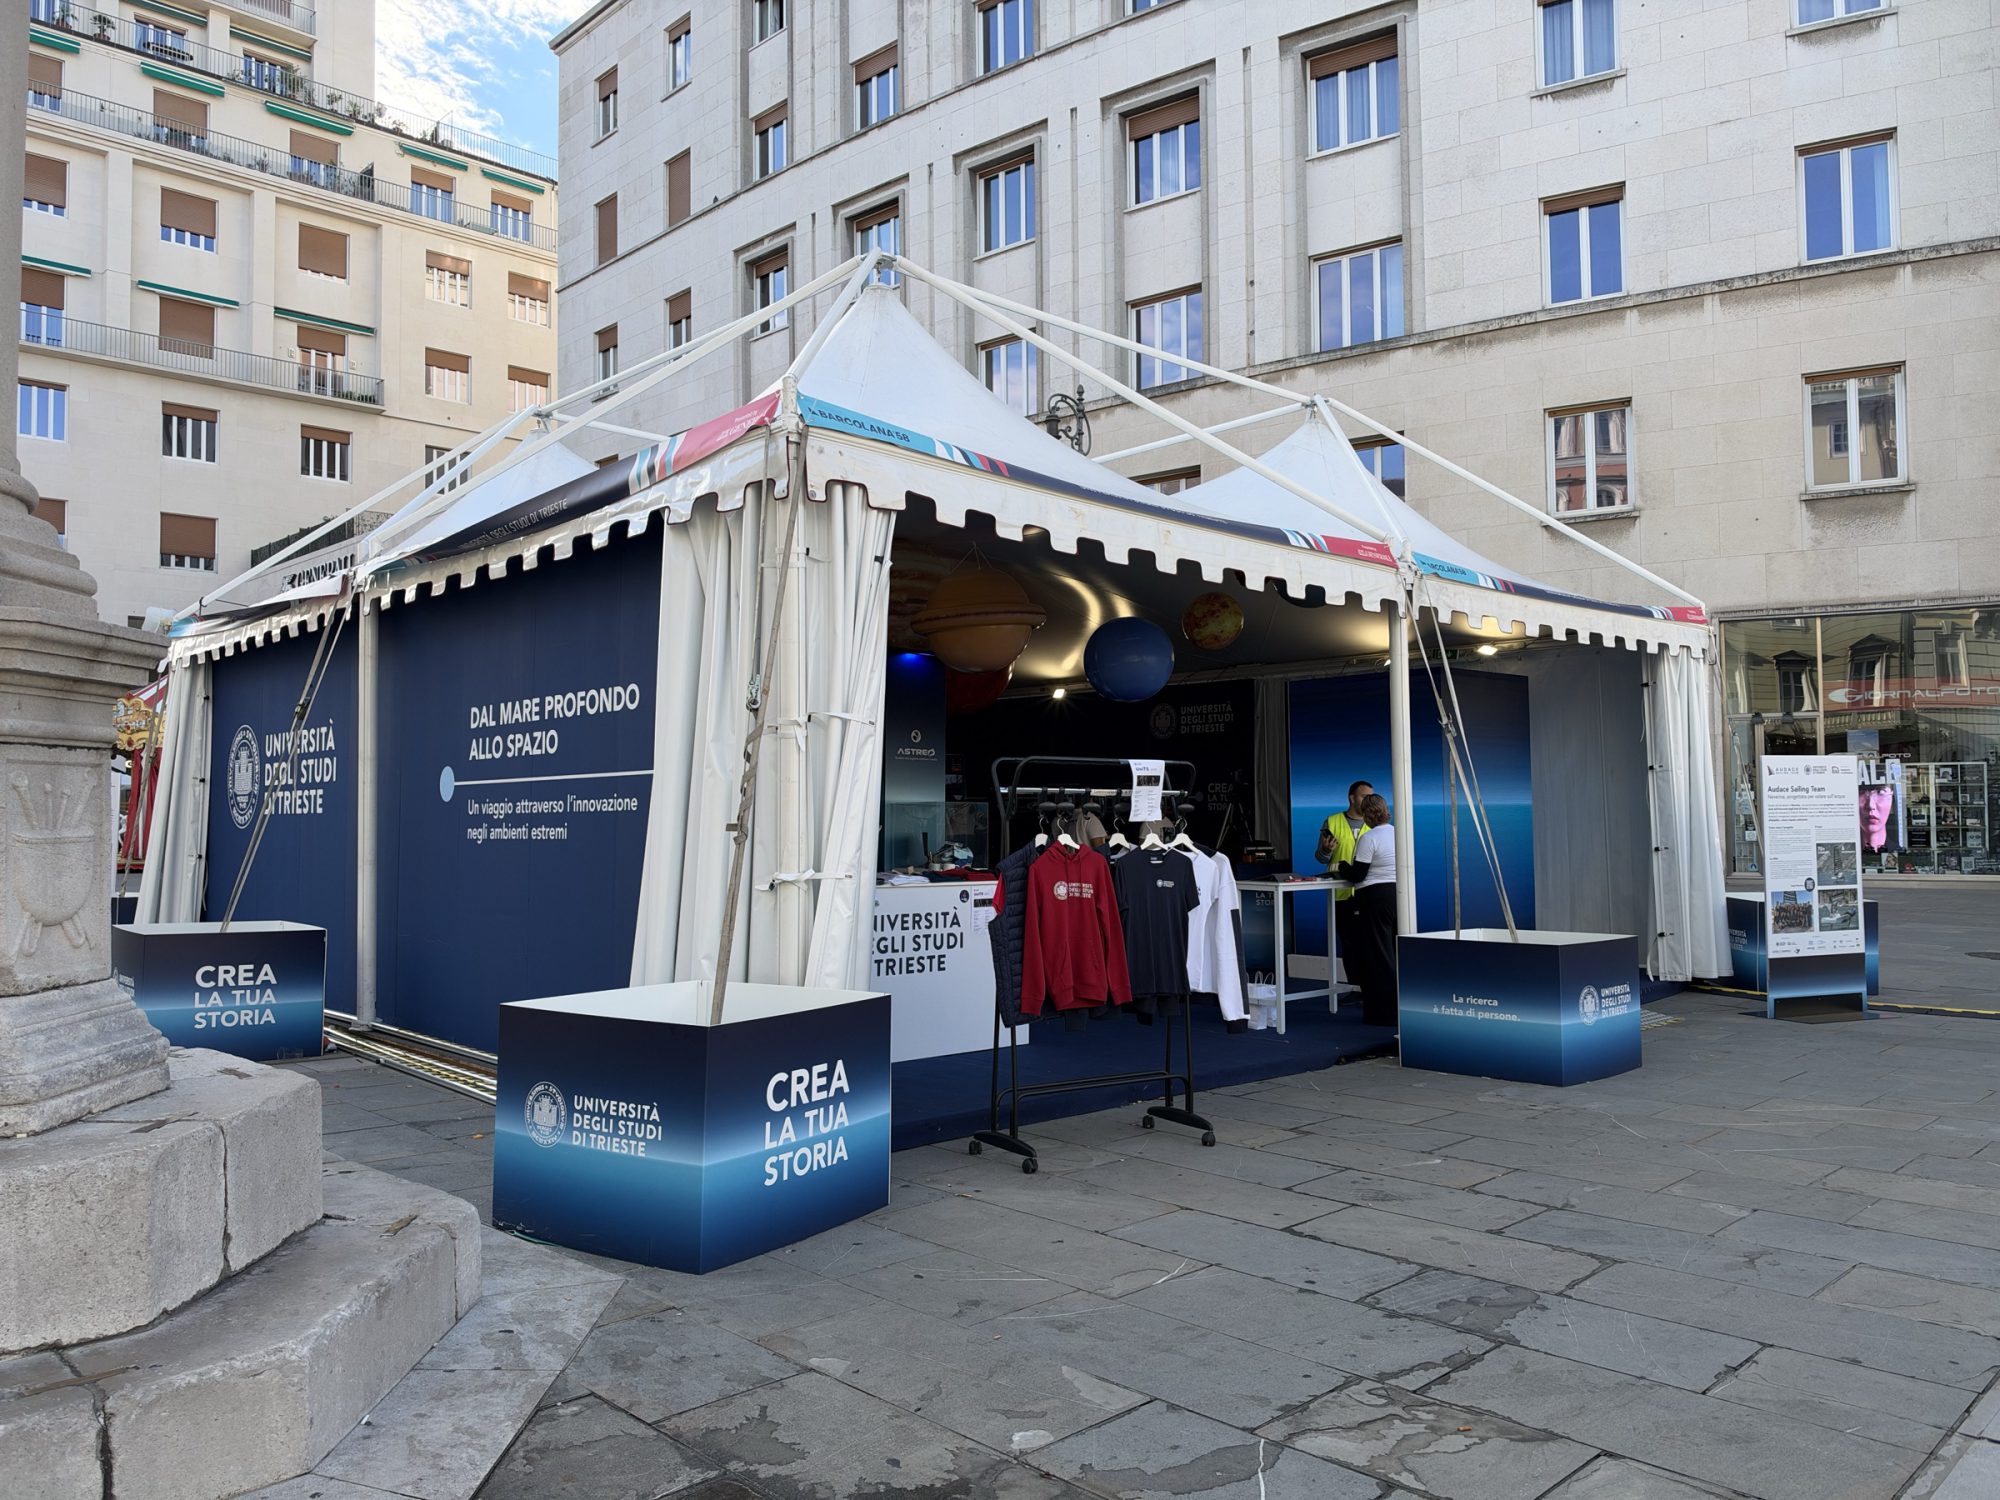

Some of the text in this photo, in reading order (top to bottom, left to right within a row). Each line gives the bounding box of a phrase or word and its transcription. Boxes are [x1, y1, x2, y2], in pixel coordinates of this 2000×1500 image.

[510, 516, 531, 532] STUDI
[530, 511, 540, 523] DI
[538, 499, 568, 519] TRIESTE
[470, 683, 640, 729] DAL MARE PROFONDO
[1180, 701, 1232, 714] UNIVERSITÀ
[1180, 713, 1234, 724] DEGLI STUDI
[1181, 723, 1224, 734] DI TRIESTE
[469, 729, 559, 760] ALLO SPAZIO
[300, 757, 336, 784] STUDI
[1790, 785, 1809, 794] Sailing
[276, 789, 323, 815] TRIESTE
[467, 800, 480, 815] Un
[481, 799, 513, 819] viaggio
[515, 799, 564, 814] attraverso
[467, 822, 568, 844] negli ambienti estremi
[873, 906, 961, 932] IVERSITÀ
[872, 931, 964, 955] GLI STUDI
[195, 963, 277, 988] CREA
[874, 954, 946, 977] TRIESTE
[194, 988, 277, 1008] LA TUA
[1452, 993, 1499, 1006] La ricerca
[1602, 992, 1631, 1008] DEGLI STUDI
[194, 1008, 276, 1029] STORIA
[1433, 1004, 1521, 1021] è fatta di persone.
[766, 1059, 850, 1112] CREA
[573, 1094, 660, 1122] UNIVERSITÀ
[573, 1112, 613, 1133] DEGLI
[618, 1120, 662, 1141] STUDI
[764, 1101, 849, 1150] LA TUA
[572, 1131, 646, 1157] DI TRIESTE
[764, 1135, 848, 1187] STORIA
